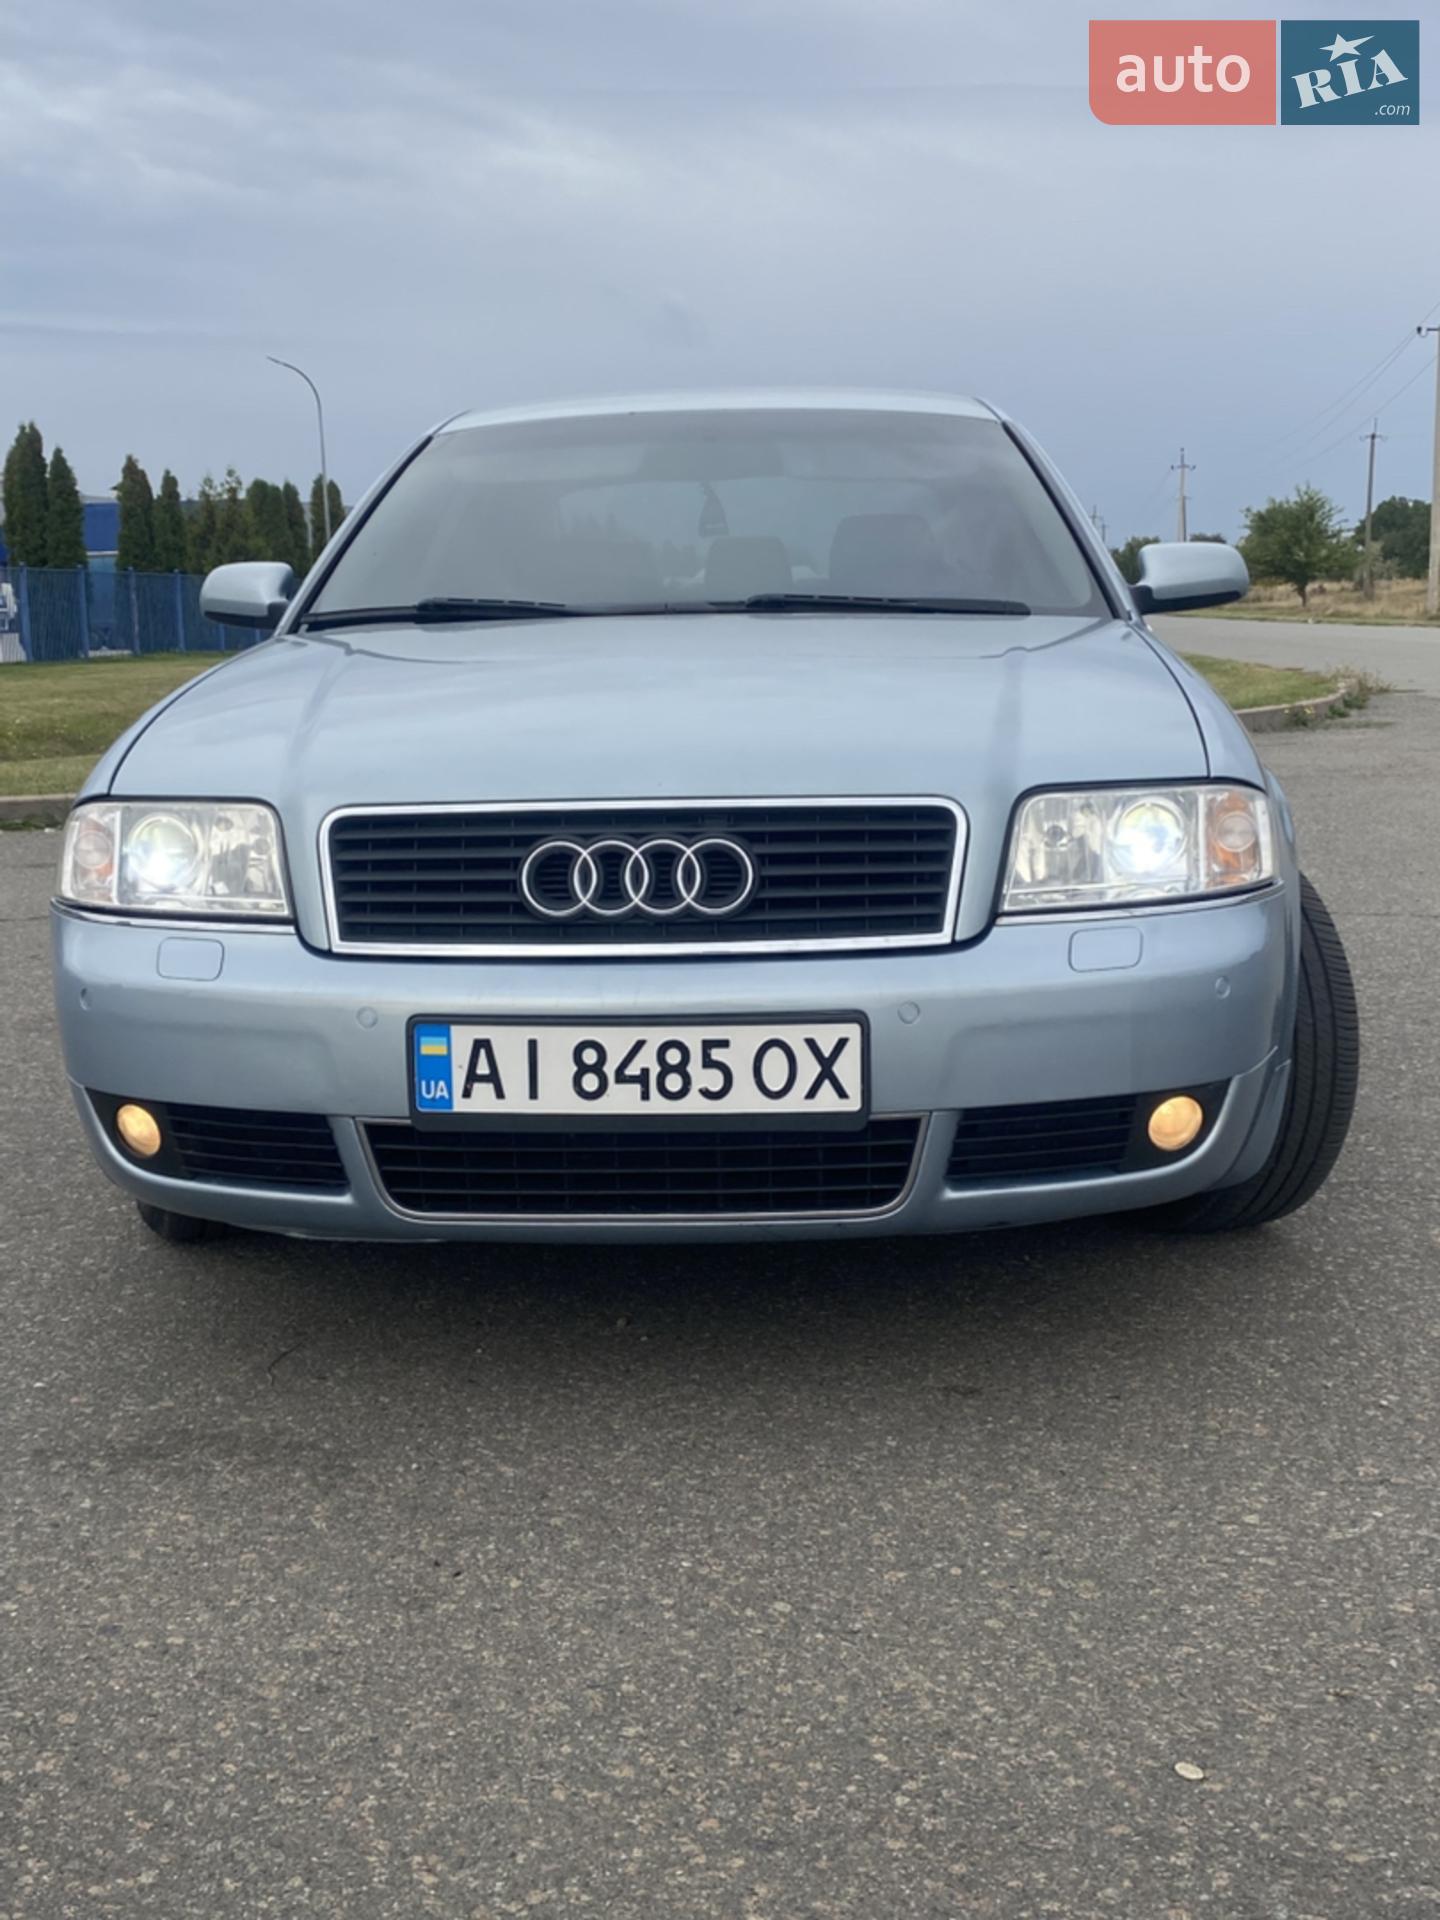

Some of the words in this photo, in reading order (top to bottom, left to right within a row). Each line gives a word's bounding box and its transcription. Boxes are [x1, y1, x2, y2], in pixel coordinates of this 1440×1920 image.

[421, 1079, 450, 1100] UA
[460, 1038, 539, 1101] AI
[571, 1039, 735, 1102] 8485
[752, 1036, 851, 1101] OX
